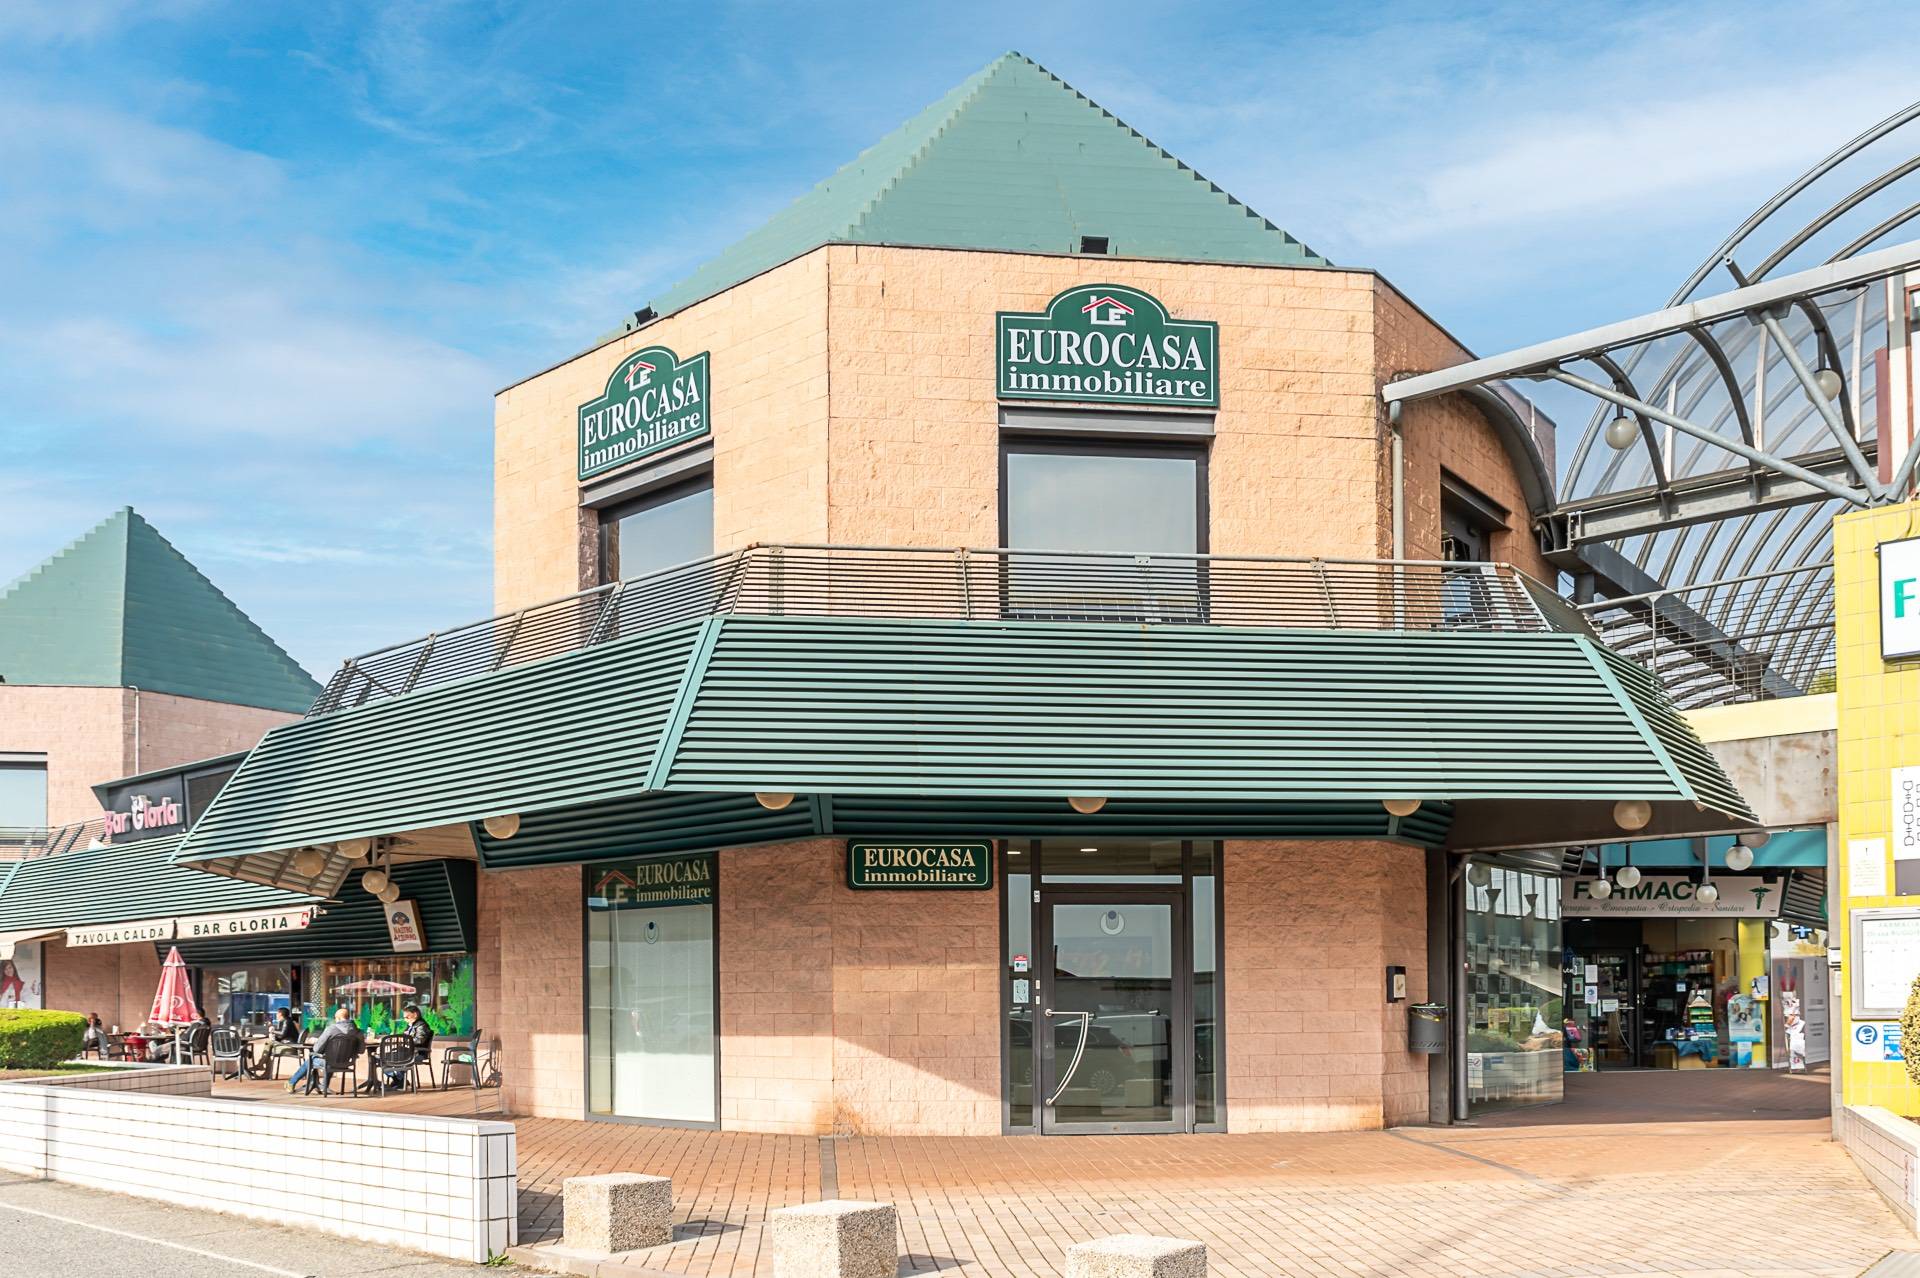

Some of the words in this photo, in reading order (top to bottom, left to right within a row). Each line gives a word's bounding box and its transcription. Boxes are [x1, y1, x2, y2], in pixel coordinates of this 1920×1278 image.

[1007, 328, 1206, 371] EUROCASA
[1008, 366, 1206, 397] immobiliare
[584, 371, 700, 447] EUROCASA
[584, 412, 700, 470] immobiliare
[1894, 577, 1920, 618] F
[104, 811, 131, 836] Bar
[131, 795, 182, 831] Gloria
[864, 848, 976, 867] EUROCASA
[637, 860, 710, 885] EUROCASA
[864, 869, 977, 882] immobiliare
[636, 885, 711, 902] immobiliare
[1573, 881, 1720, 900] FRMAC
[75, 931, 119, 944] TAVOLA
[123, 927, 164, 941] CALDA
[193, 923, 220, 935] BAR
[229, 916, 288, 933] GLORIA
